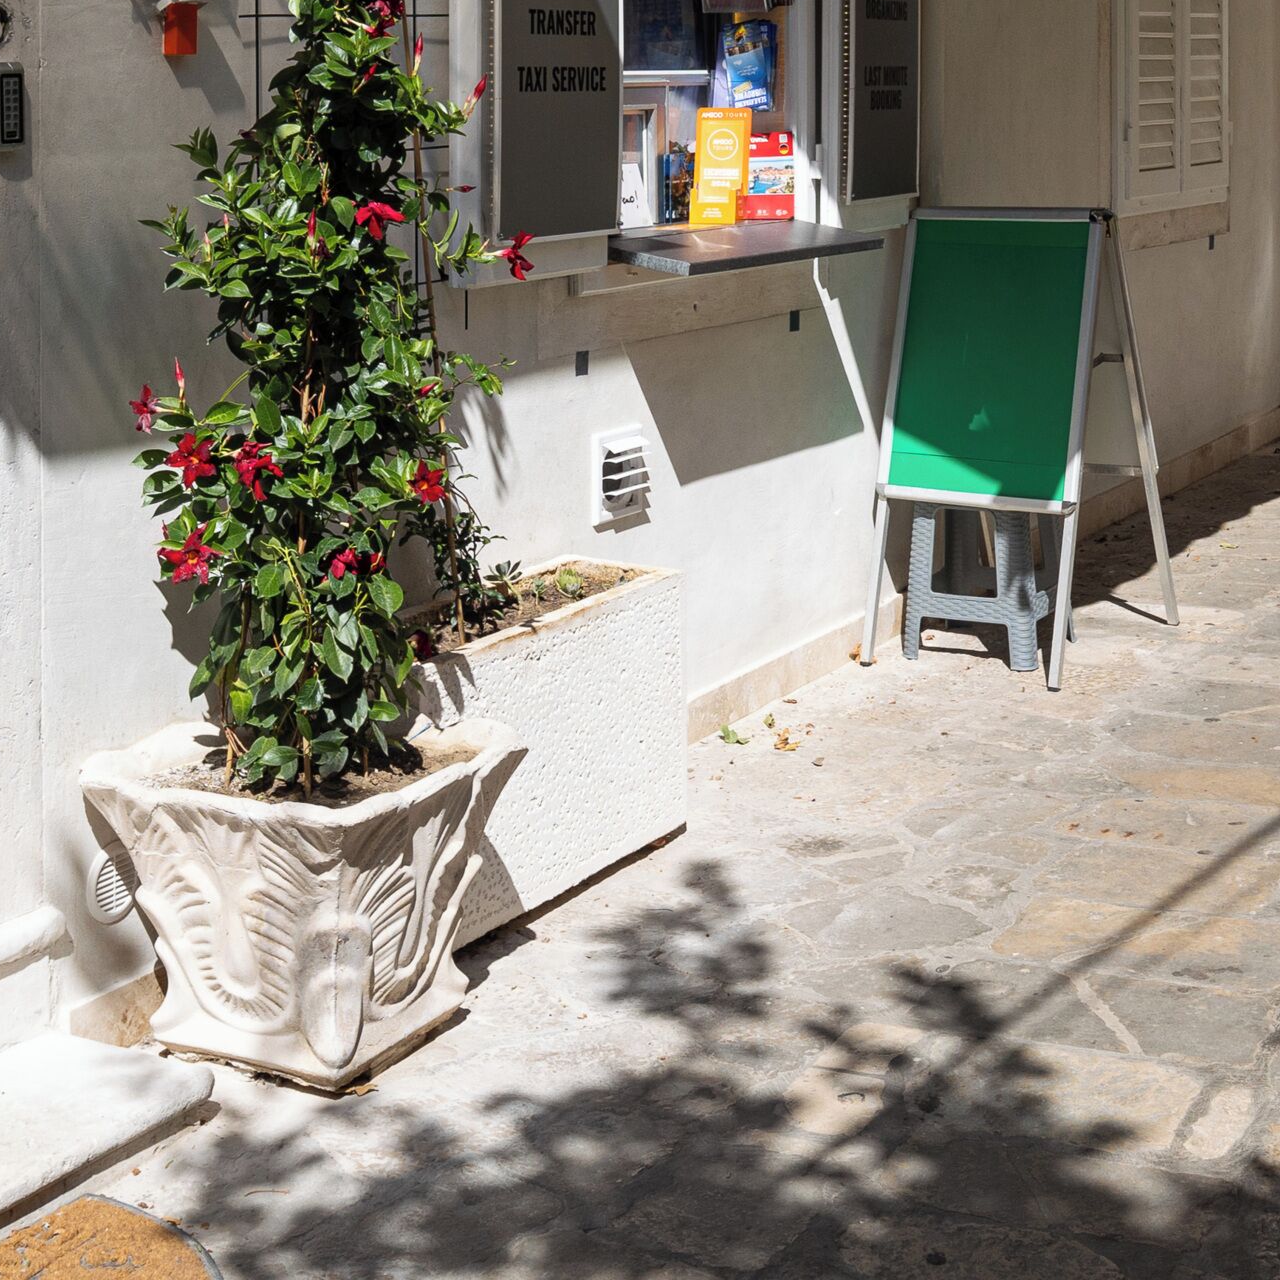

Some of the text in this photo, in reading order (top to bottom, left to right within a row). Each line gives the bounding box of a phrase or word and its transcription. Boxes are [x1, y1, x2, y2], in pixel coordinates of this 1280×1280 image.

[866, 0, 907, 21] ORGANIZING
[529, 8, 596, 36] TRANSFER
[517, 66, 606, 92] TAXI SERVICE
[864, 66, 908, 86] LAST MINUTE
[870, 89, 902, 111] BOOKING
